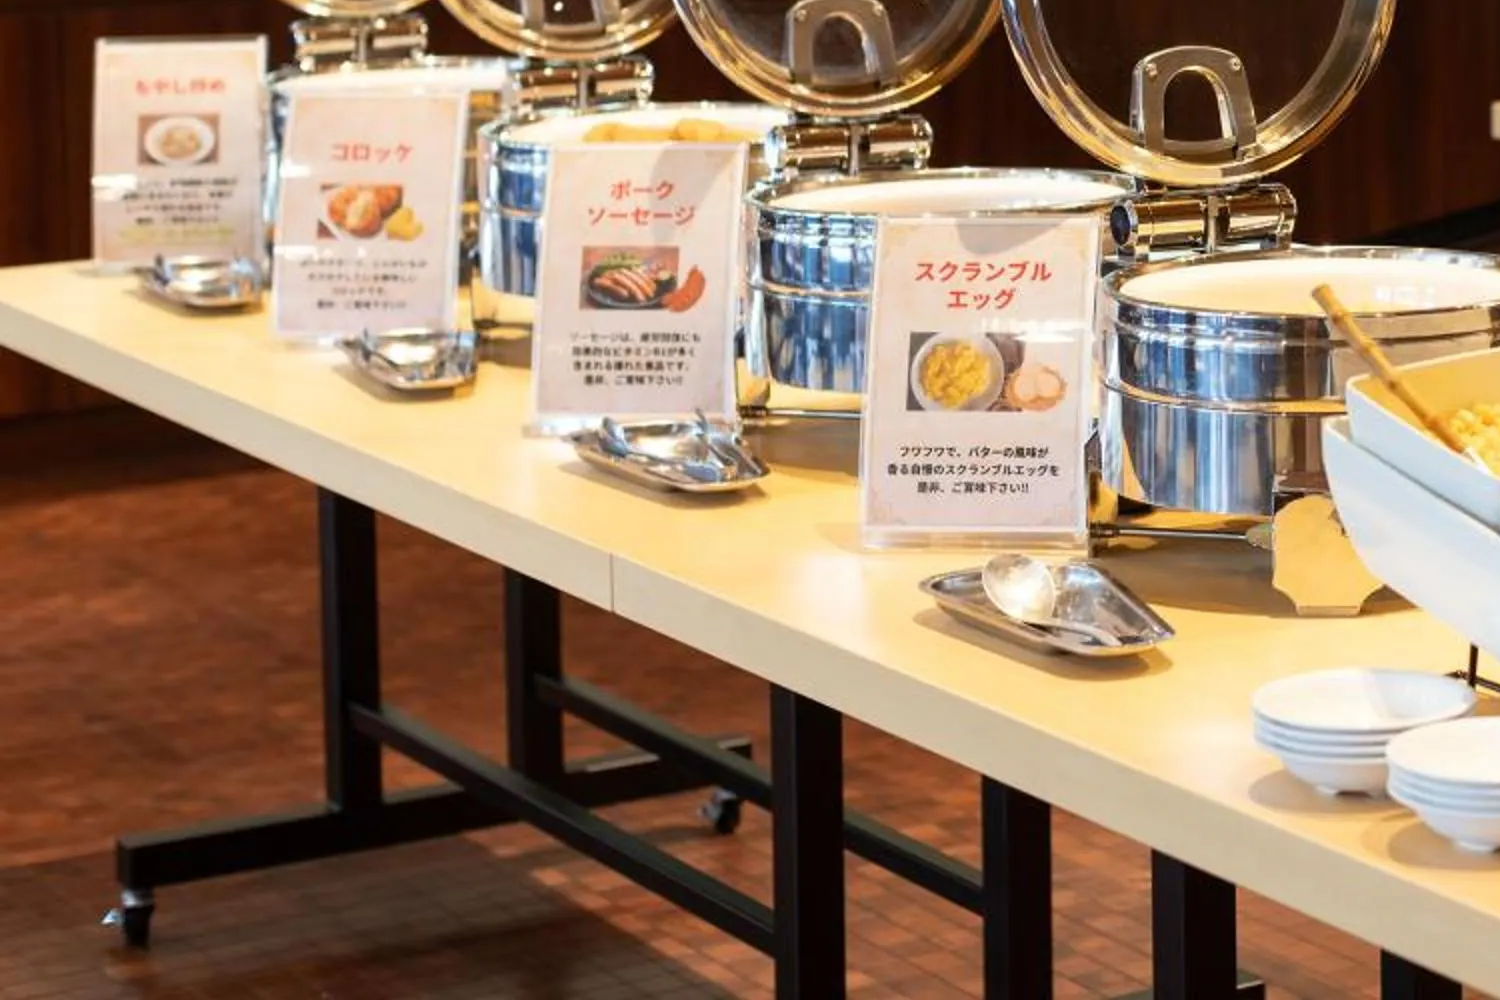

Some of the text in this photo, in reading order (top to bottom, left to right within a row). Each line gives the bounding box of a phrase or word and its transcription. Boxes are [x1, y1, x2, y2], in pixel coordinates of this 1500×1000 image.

[329, 143, 414, 164] コロッケ
[610, 179, 675, 200] ポーク
[588, 205, 696, 227] ソーセージ
[915, 261, 1052, 283] スクランブル
[947, 287, 1017, 310] エッグ
